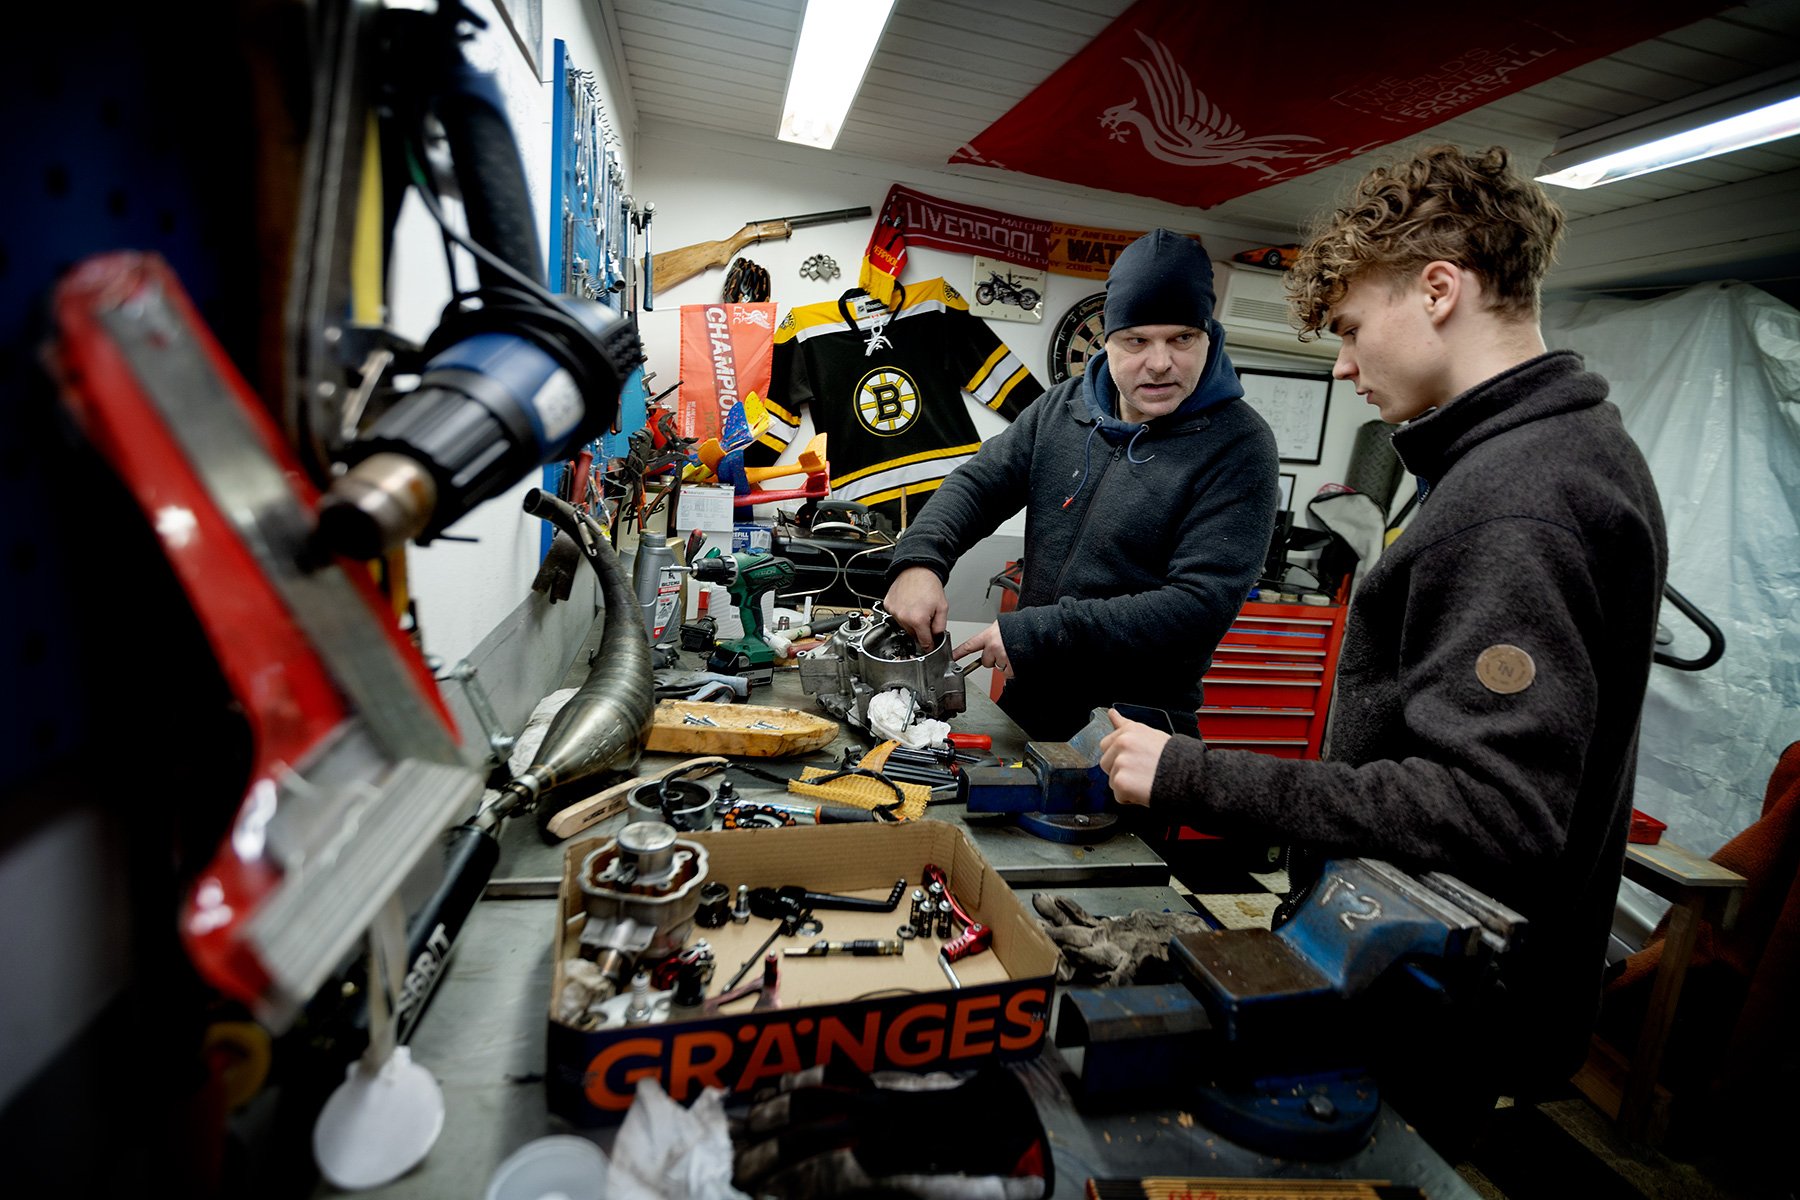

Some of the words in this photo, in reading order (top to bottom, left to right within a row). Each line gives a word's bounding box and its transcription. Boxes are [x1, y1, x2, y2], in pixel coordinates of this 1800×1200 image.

[1349, 75, 1402, 100] THE
[1366, 48, 1490, 106] WORLD'S
[1384, 44, 1519, 112] GREATEST
[1399, 48, 1558, 116] FOOTBALL
[1415, 75, 1512, 119] FAMILY
[906, 202, 1040, 256] LIVERPOOL
[1001, 217, 1062, 235] MATCHDAY
[1064, 228, 1081, 238] AT
[1081, 230, 1128, 242] ANFIELD
[1066, 262, 1093, 273] 2016
[732, 306, 743, 325] LFC
[870, 380, 904, 422] B
[585, 989, 1046, 1111] GRÄNGES
